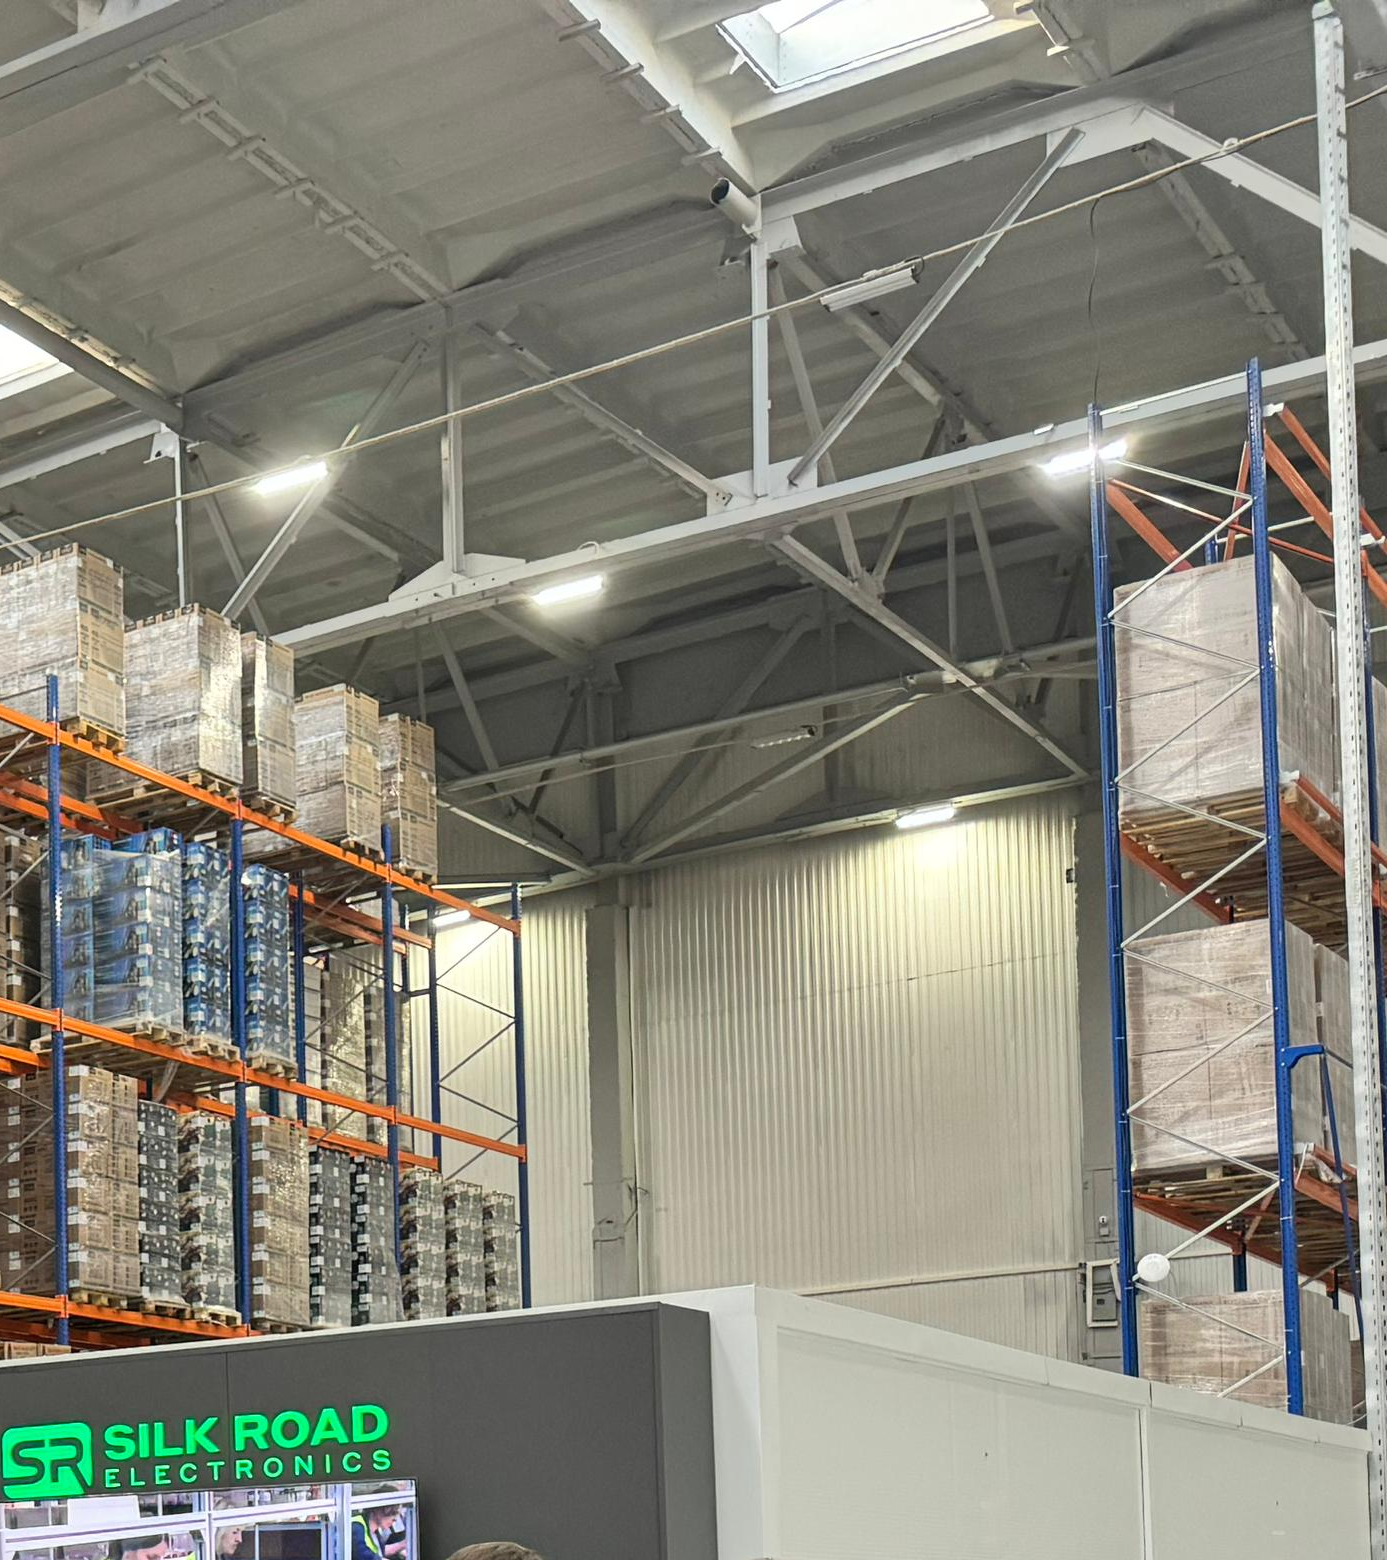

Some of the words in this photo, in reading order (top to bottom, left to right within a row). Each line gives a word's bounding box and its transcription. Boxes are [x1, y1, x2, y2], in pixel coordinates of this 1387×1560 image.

[7, 1430, 89, 1490] SR
[104, 1417, 219, 1461] SILK
[233, 1404, 389, 1452] ROAD
[104, 1449, 393, 1489] ELECTRONICS
